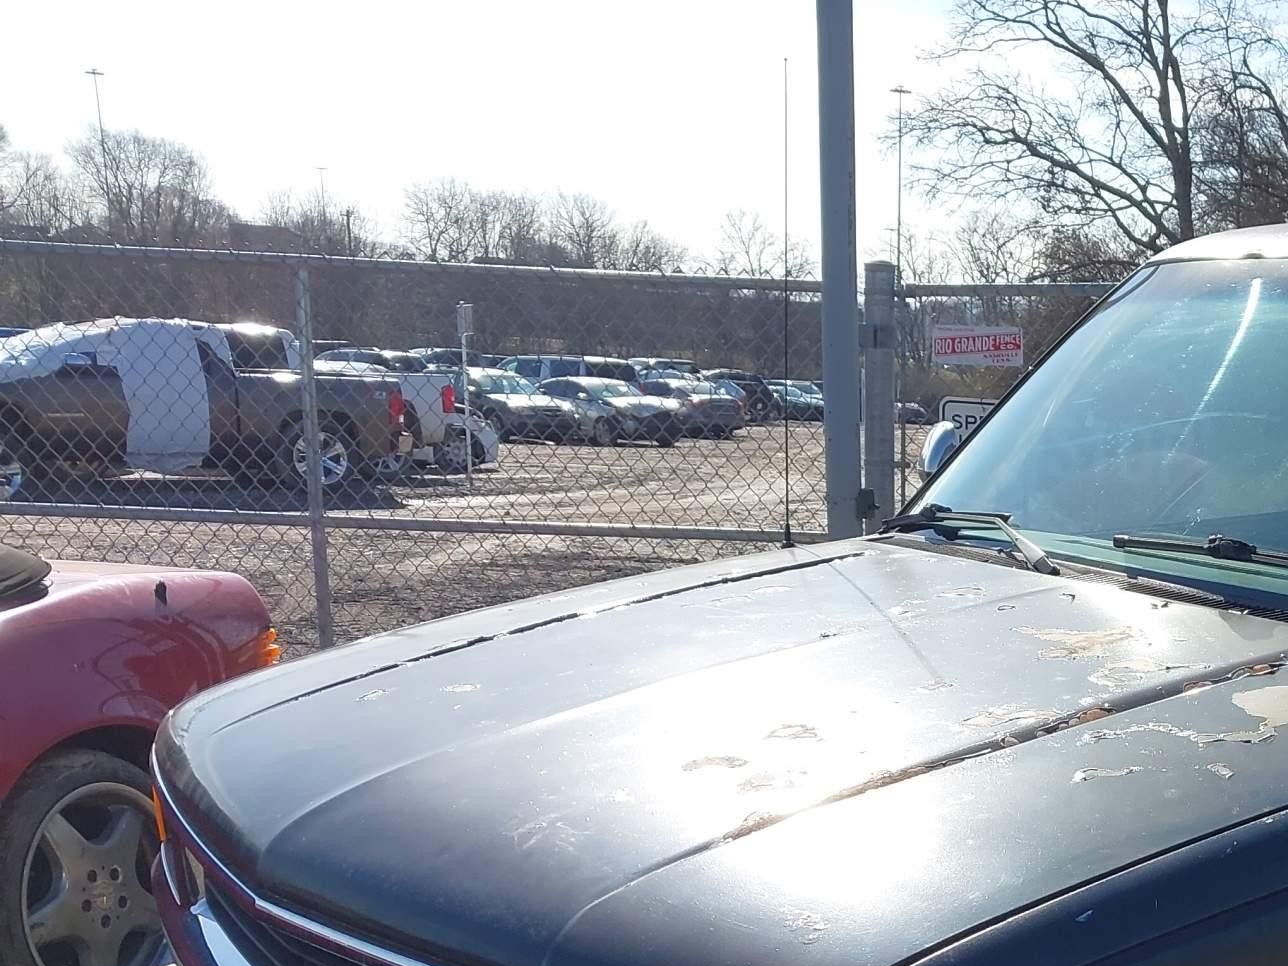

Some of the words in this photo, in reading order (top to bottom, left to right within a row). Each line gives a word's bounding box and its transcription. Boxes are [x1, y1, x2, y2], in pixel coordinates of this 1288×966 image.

[935, 338, 952, 354] RIO
[954, 335, 995, 353] GRANDE
[996, 334, 1020, 345] FENCE
